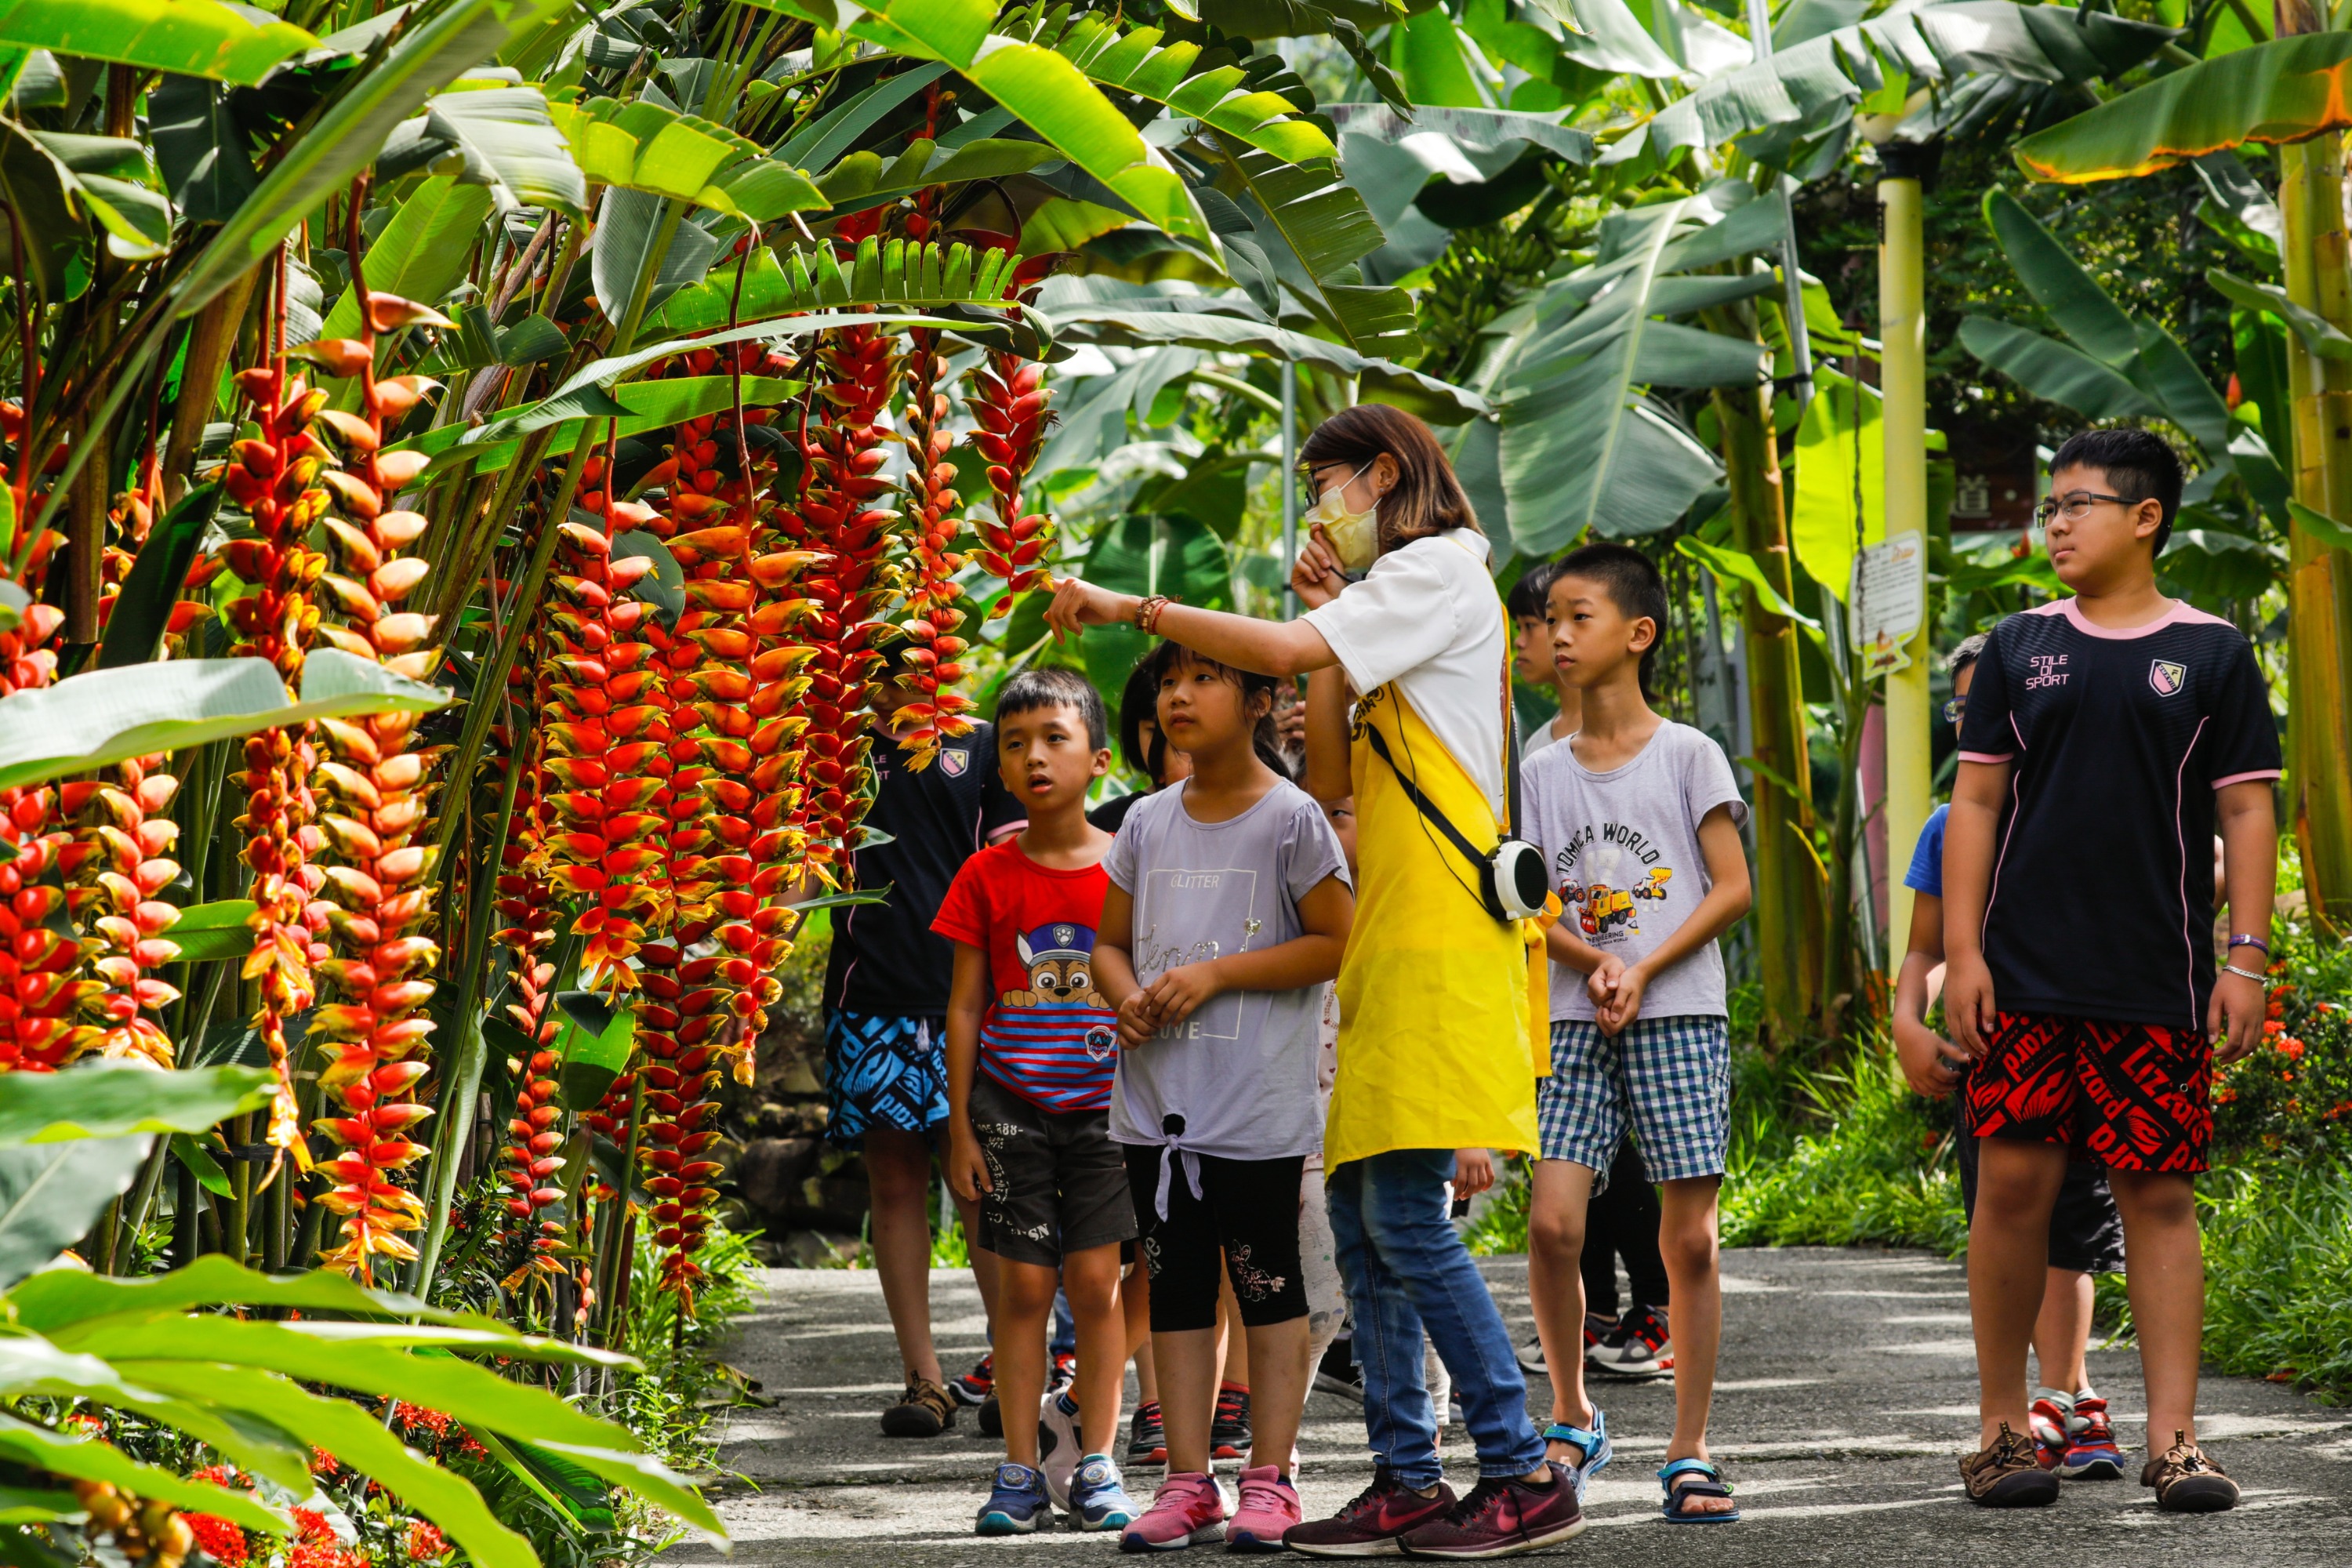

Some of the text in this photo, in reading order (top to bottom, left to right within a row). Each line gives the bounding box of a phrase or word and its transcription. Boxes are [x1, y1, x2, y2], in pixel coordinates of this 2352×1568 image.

[2030, 655, 2068, 667] STILE
[2040, 666, 2053, 677] DI
[2026, 674, 2070, 690] SPORT
[1556, 822, 1661, 874] TOMICA WORLD
[1171, 874, 1220, 888] GLITTER
[1151, 1022, 1200, 1040] OVE
